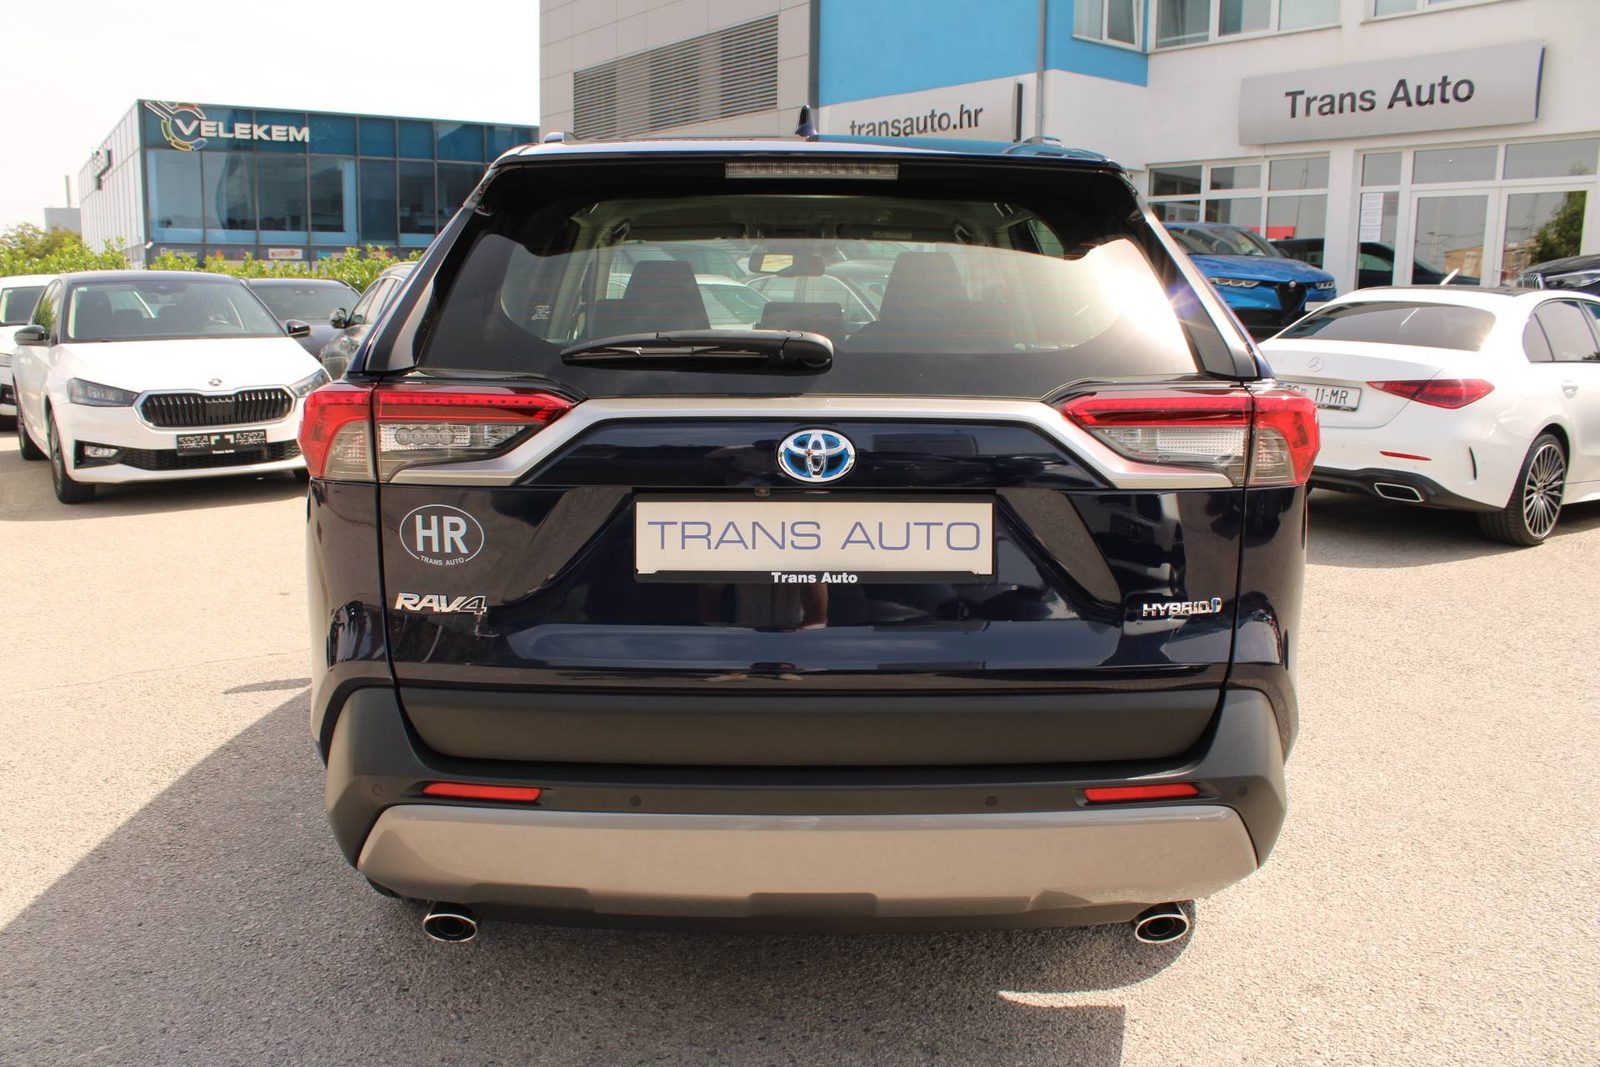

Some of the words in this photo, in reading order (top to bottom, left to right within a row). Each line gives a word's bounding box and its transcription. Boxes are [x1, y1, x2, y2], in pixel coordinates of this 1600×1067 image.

[1285, 90, 1376, 118] Trans
[1387, 75, 1474, 109] Auto
[175, 119, 310, 143] VELEKEM
[849, 104, 983, 137] transauto.hr
[415, 514, 469, 554] HR
[647, 521, 822, 550] TRANS
[840, 521, 981, 551] AUTO
[420, 554, 443, 566] TRANS
[445, 557, 465, 566] AUTO
[771, 571, 817, 583] Trans
[820, 572, 858, 584] Auto
[394, 592, 487, 615] RAV4
[1142, 600, 1210, 617] HYBRID
